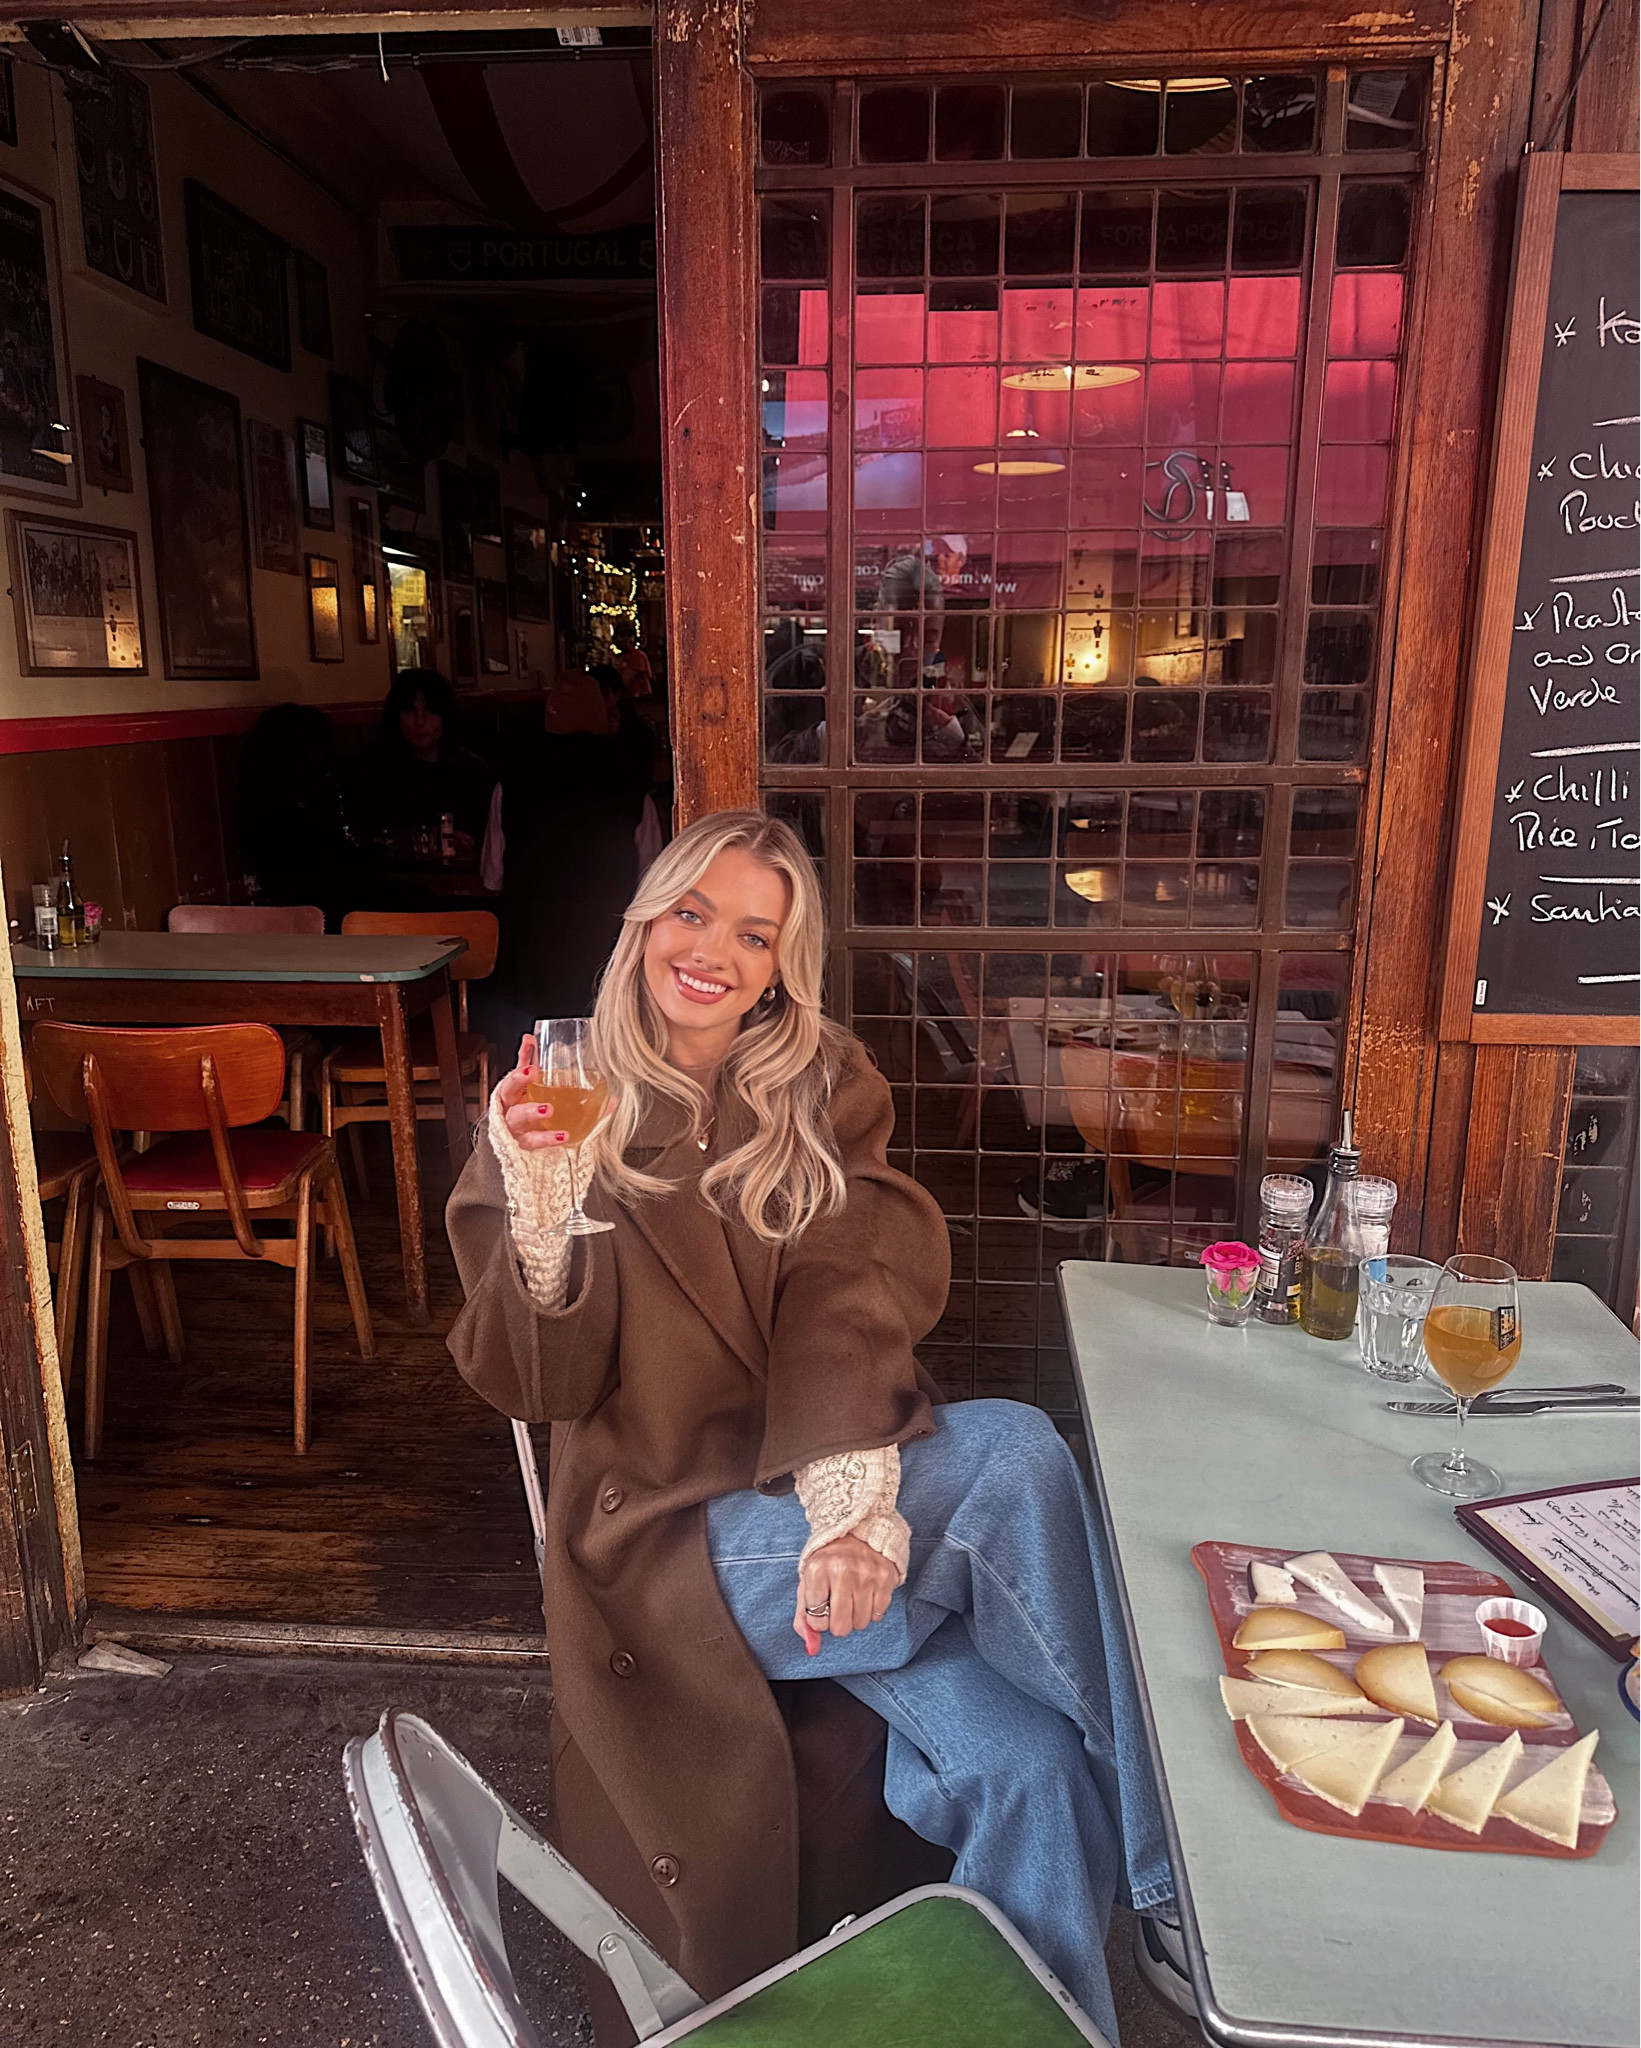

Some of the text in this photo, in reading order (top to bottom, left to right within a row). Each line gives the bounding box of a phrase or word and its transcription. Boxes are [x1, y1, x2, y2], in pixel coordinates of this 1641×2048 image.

[482, 240, 628, 267] PORTUGAL
[1530, 677, 1621, 717] Verde
[1532, 765, 1630, 806] Chilli
